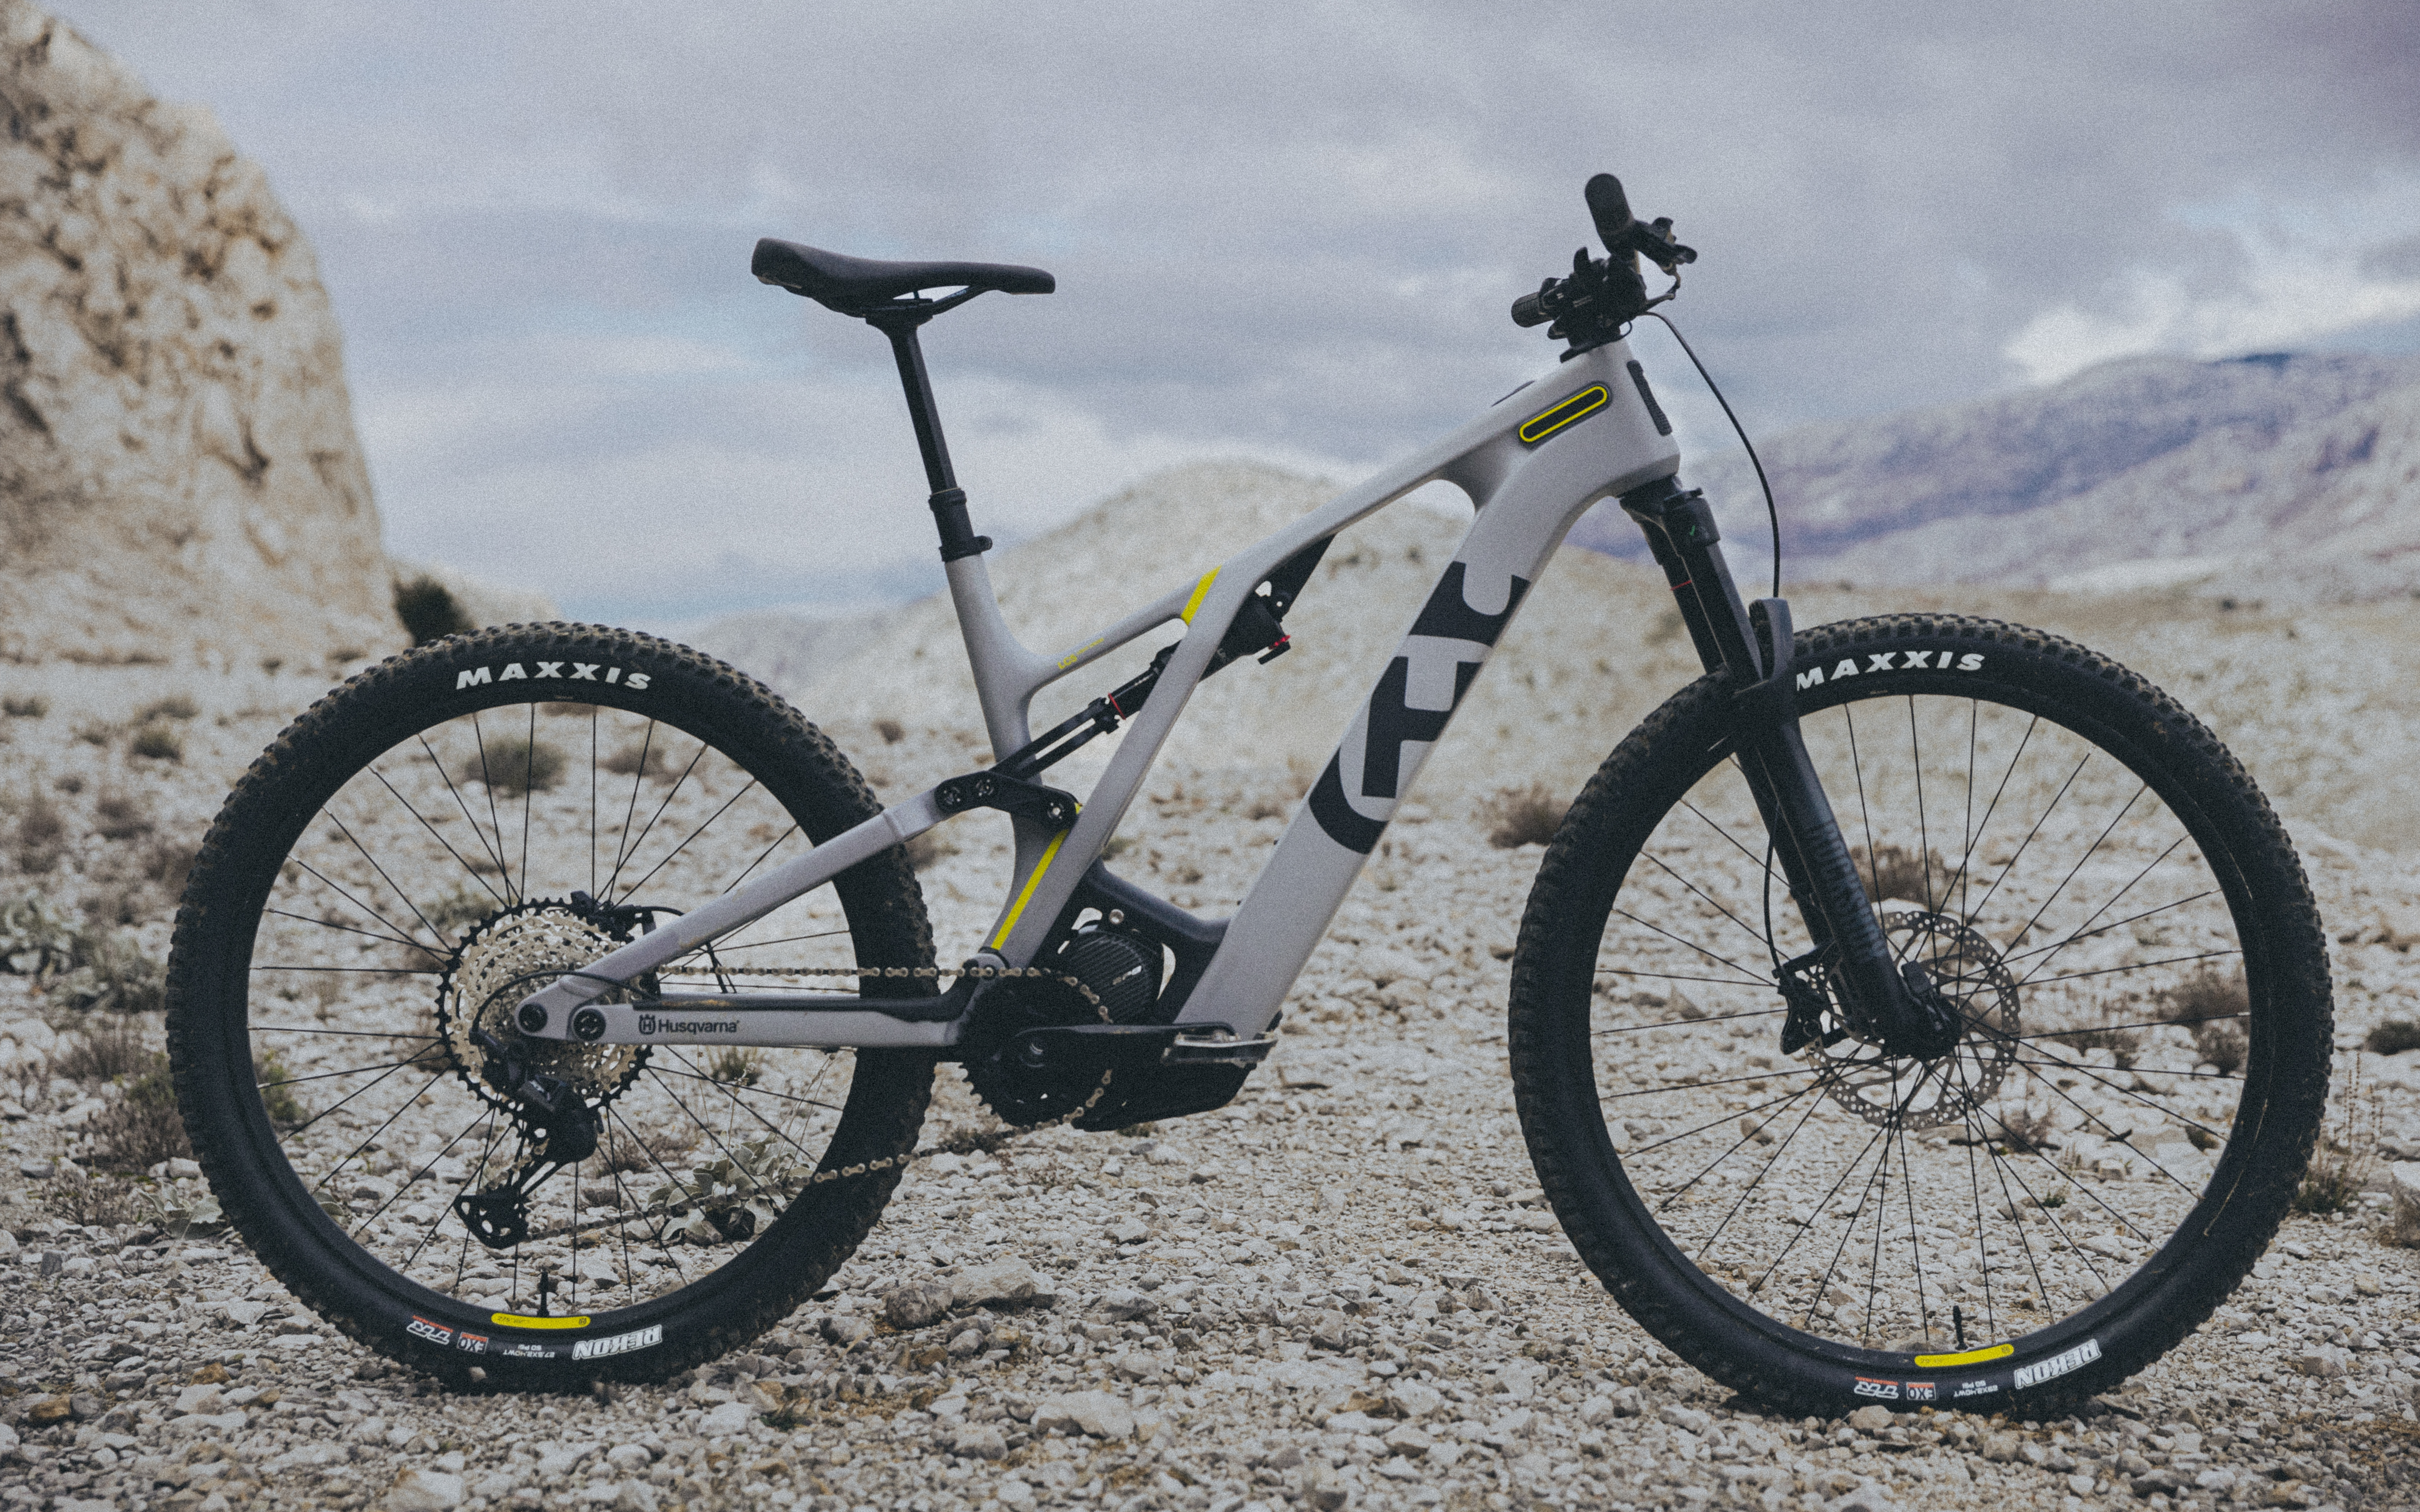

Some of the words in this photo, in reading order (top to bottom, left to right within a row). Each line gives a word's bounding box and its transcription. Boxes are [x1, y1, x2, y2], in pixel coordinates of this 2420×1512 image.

[456, 661, 651, 689] MAXXIS
[1796, 651, 1985, 691] MAXXIS
[658, 1019, 737, 1034] Husqvarna
[407, 1320, 450, 1345] TR
[573, 1324, 662, 1360] REKON
[458, 1337, 486, 1354] EXO
[2015, 1339, 2102, 1389] REKON
[1854, 1381, 1899, 1399] TR
[1908, 1388, 1935, 1399] EXO
